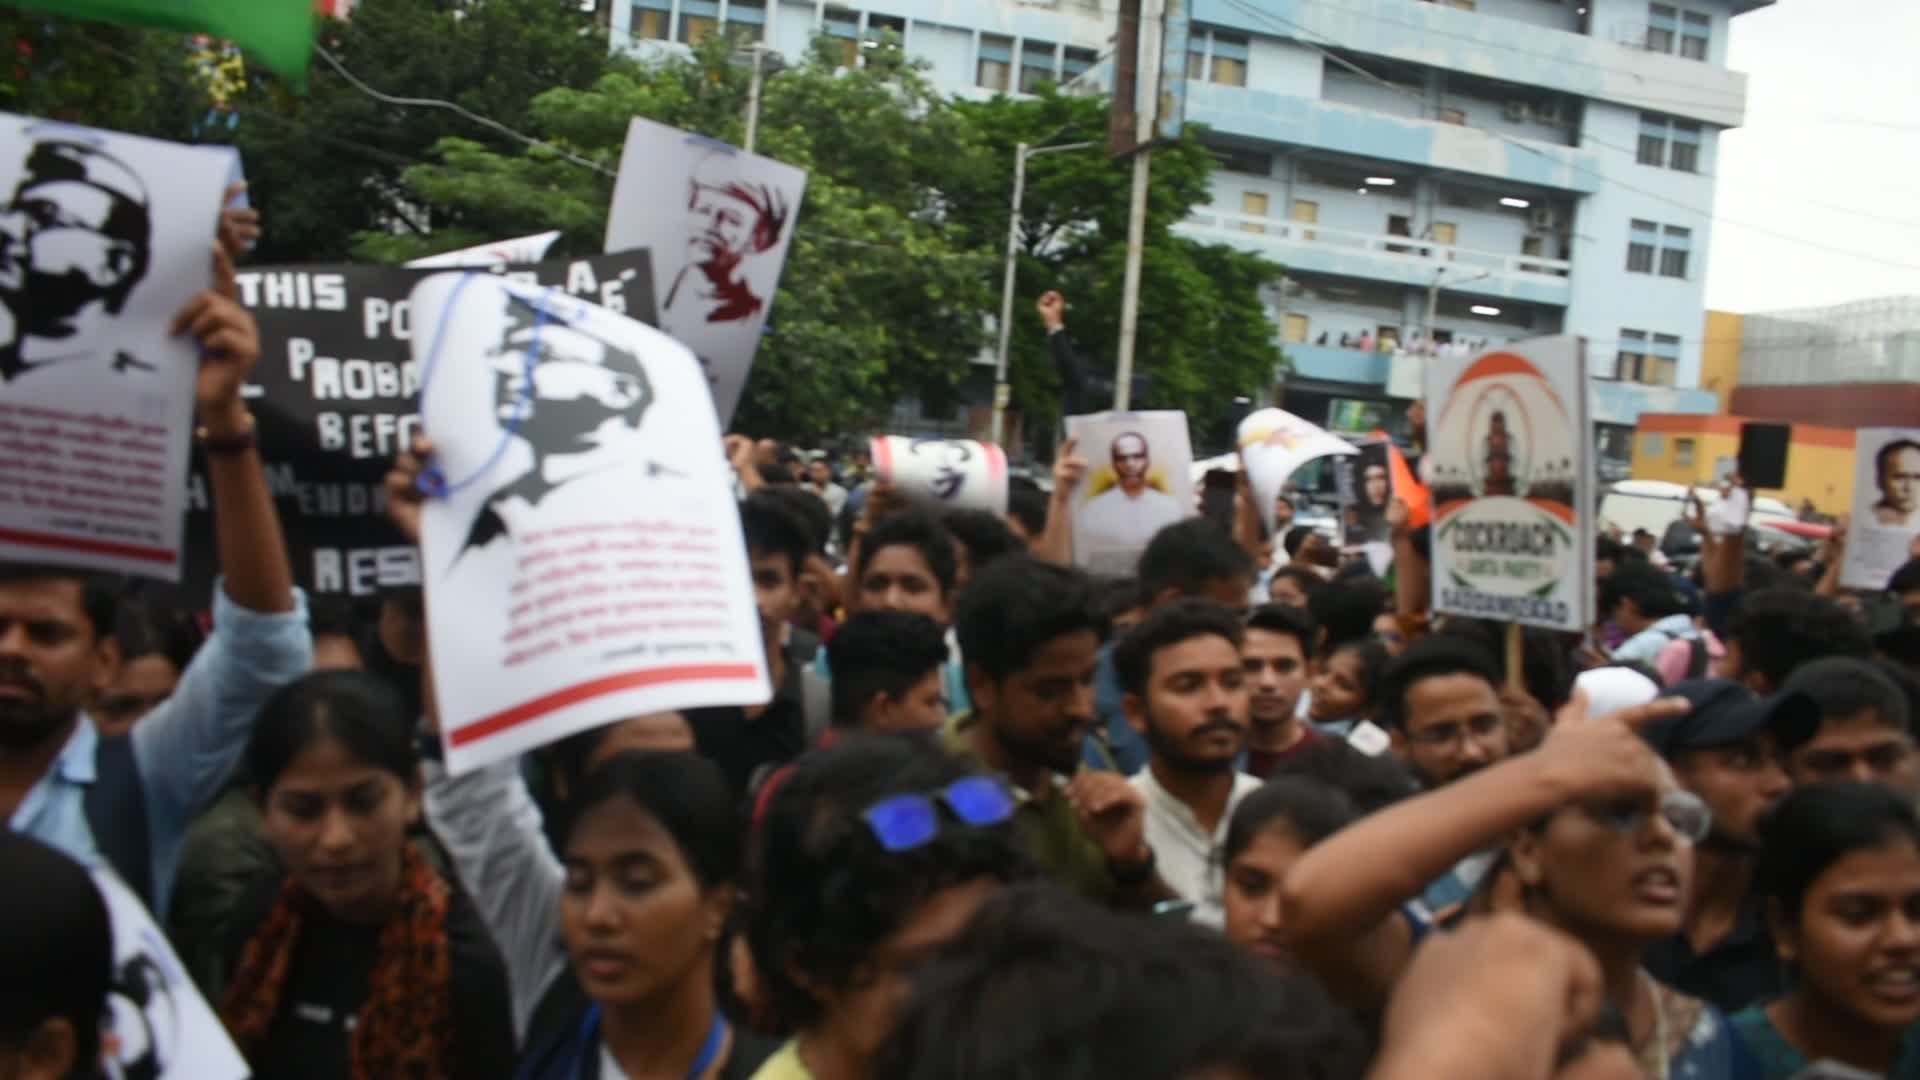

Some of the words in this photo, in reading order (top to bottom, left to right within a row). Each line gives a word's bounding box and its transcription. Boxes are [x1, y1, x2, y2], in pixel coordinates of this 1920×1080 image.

[235, 272, 347, 311] THIS
[288, 337, 421, 399] PROBA
[1454, 520, 1555, 557] COCKROACH
